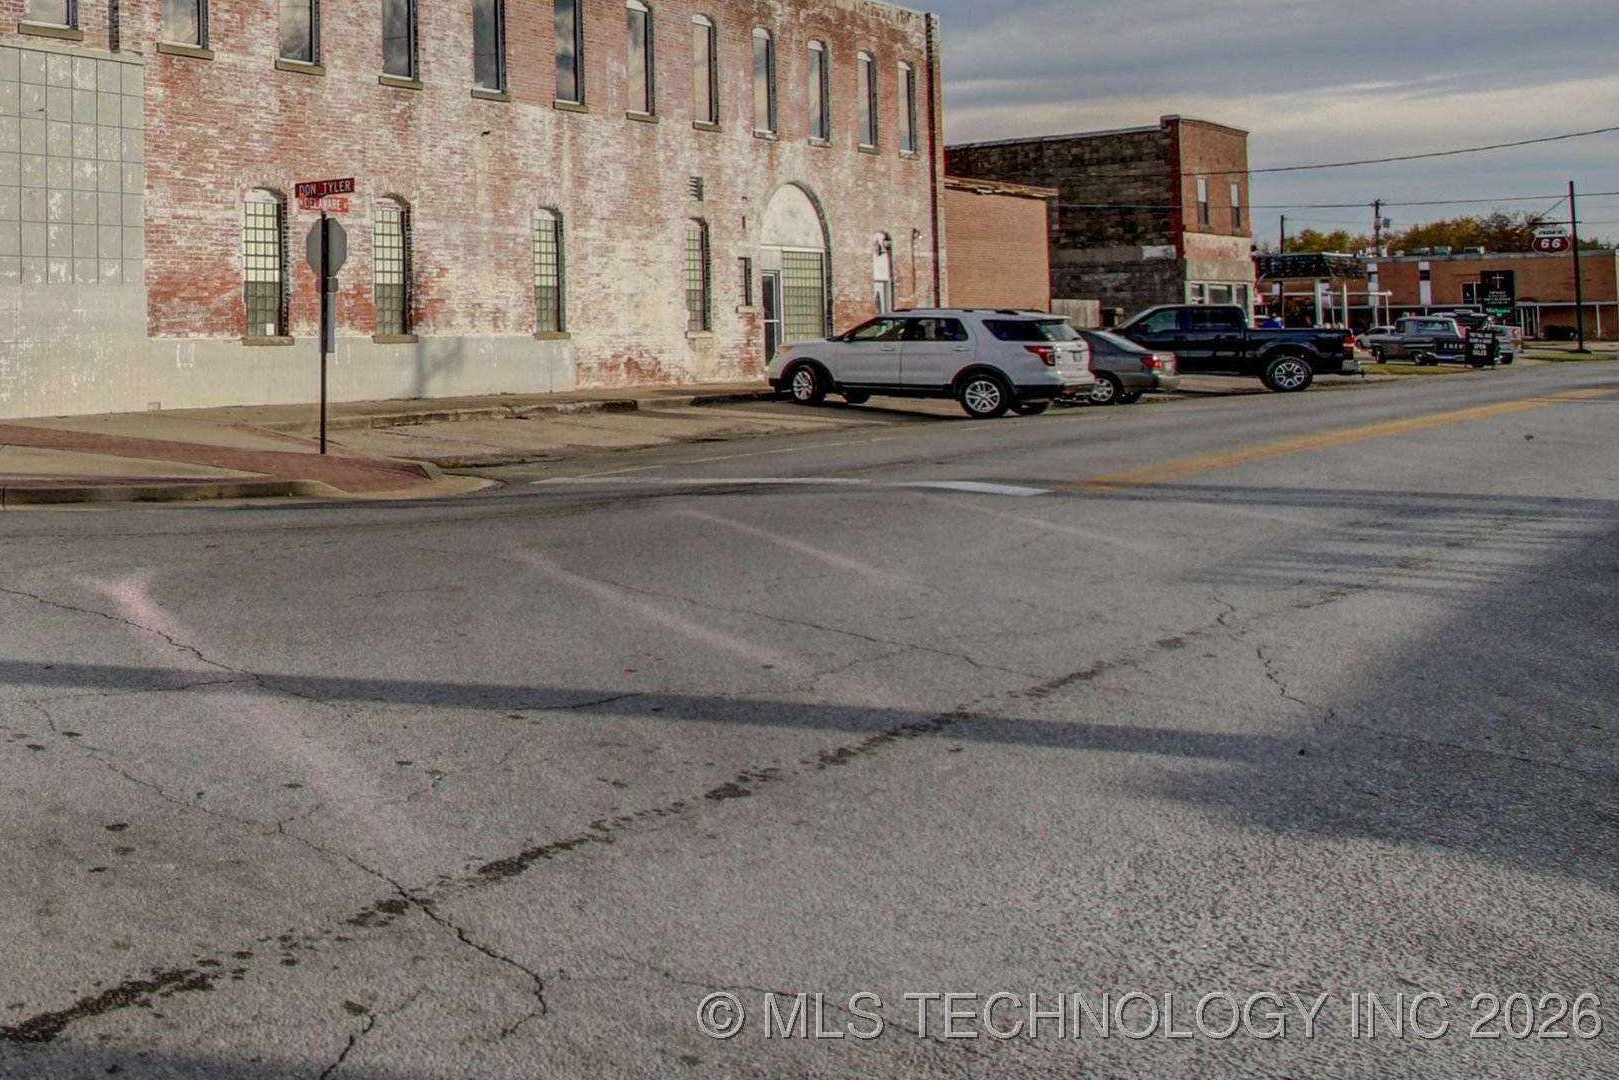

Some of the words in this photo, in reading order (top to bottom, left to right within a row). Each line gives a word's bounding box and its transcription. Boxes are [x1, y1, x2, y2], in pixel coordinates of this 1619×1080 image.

[299, 184, 317, 196] DON
[322, 180, 351, 193] TYLER
[1540, 238, 1562, 249] 66
